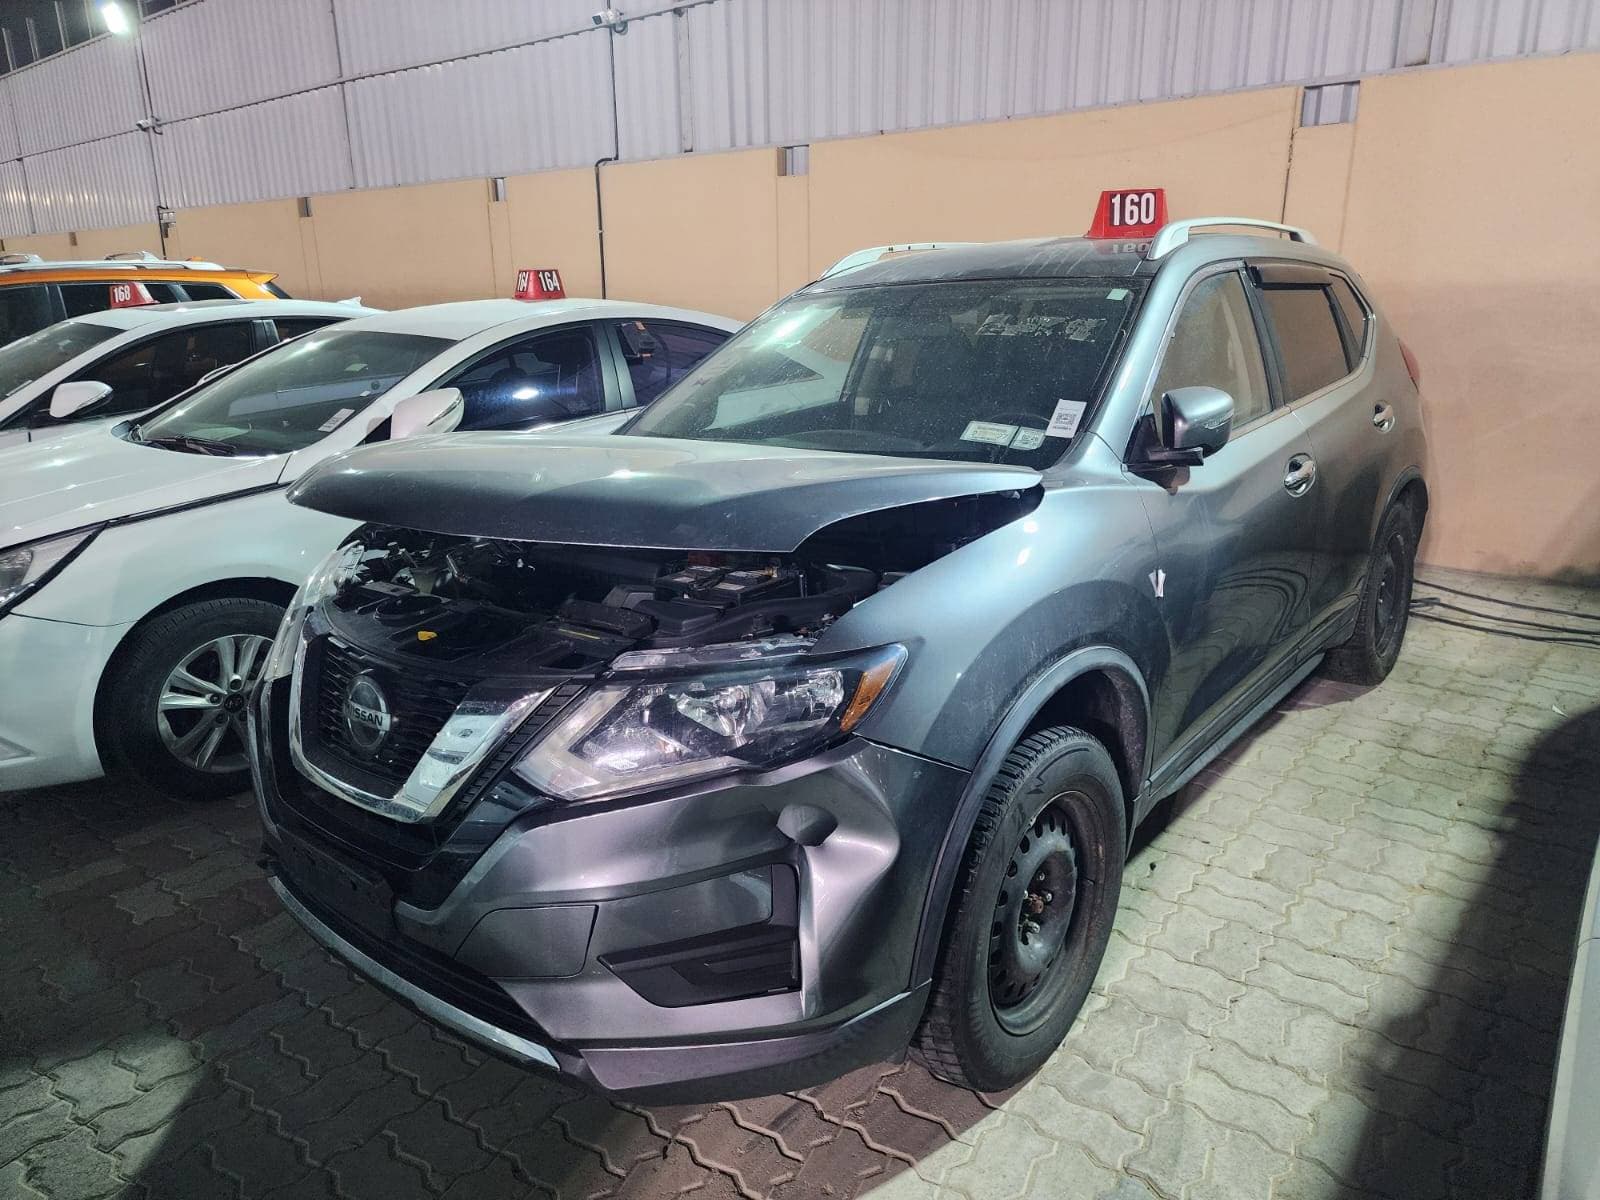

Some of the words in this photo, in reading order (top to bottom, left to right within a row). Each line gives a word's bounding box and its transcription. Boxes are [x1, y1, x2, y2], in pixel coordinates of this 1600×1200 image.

[1111, 192, 1155, 226] 160
[538, 270, 560, 292] 164
[113, 284, 131, 304] 168
